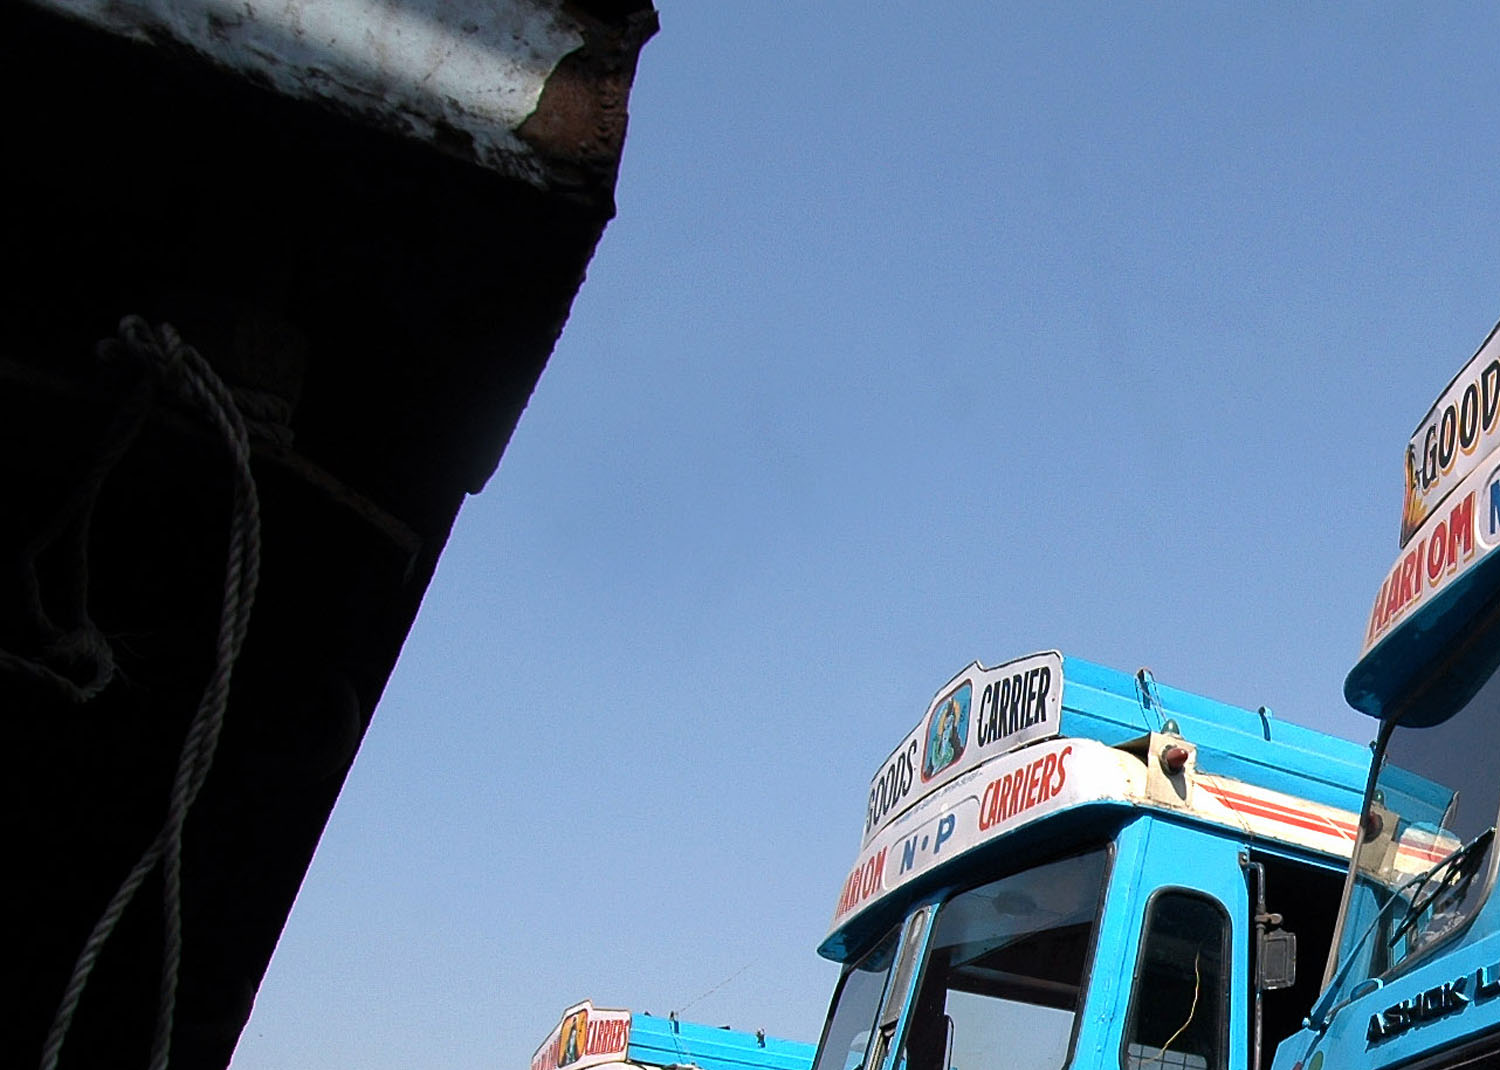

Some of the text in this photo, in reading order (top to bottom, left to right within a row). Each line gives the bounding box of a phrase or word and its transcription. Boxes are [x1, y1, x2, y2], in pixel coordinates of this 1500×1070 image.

[865, 738, 918, 834] GOODS
[976, 665, 1051, 748] CARRIER
[978, 745, 1073, 832] CARRIERS
